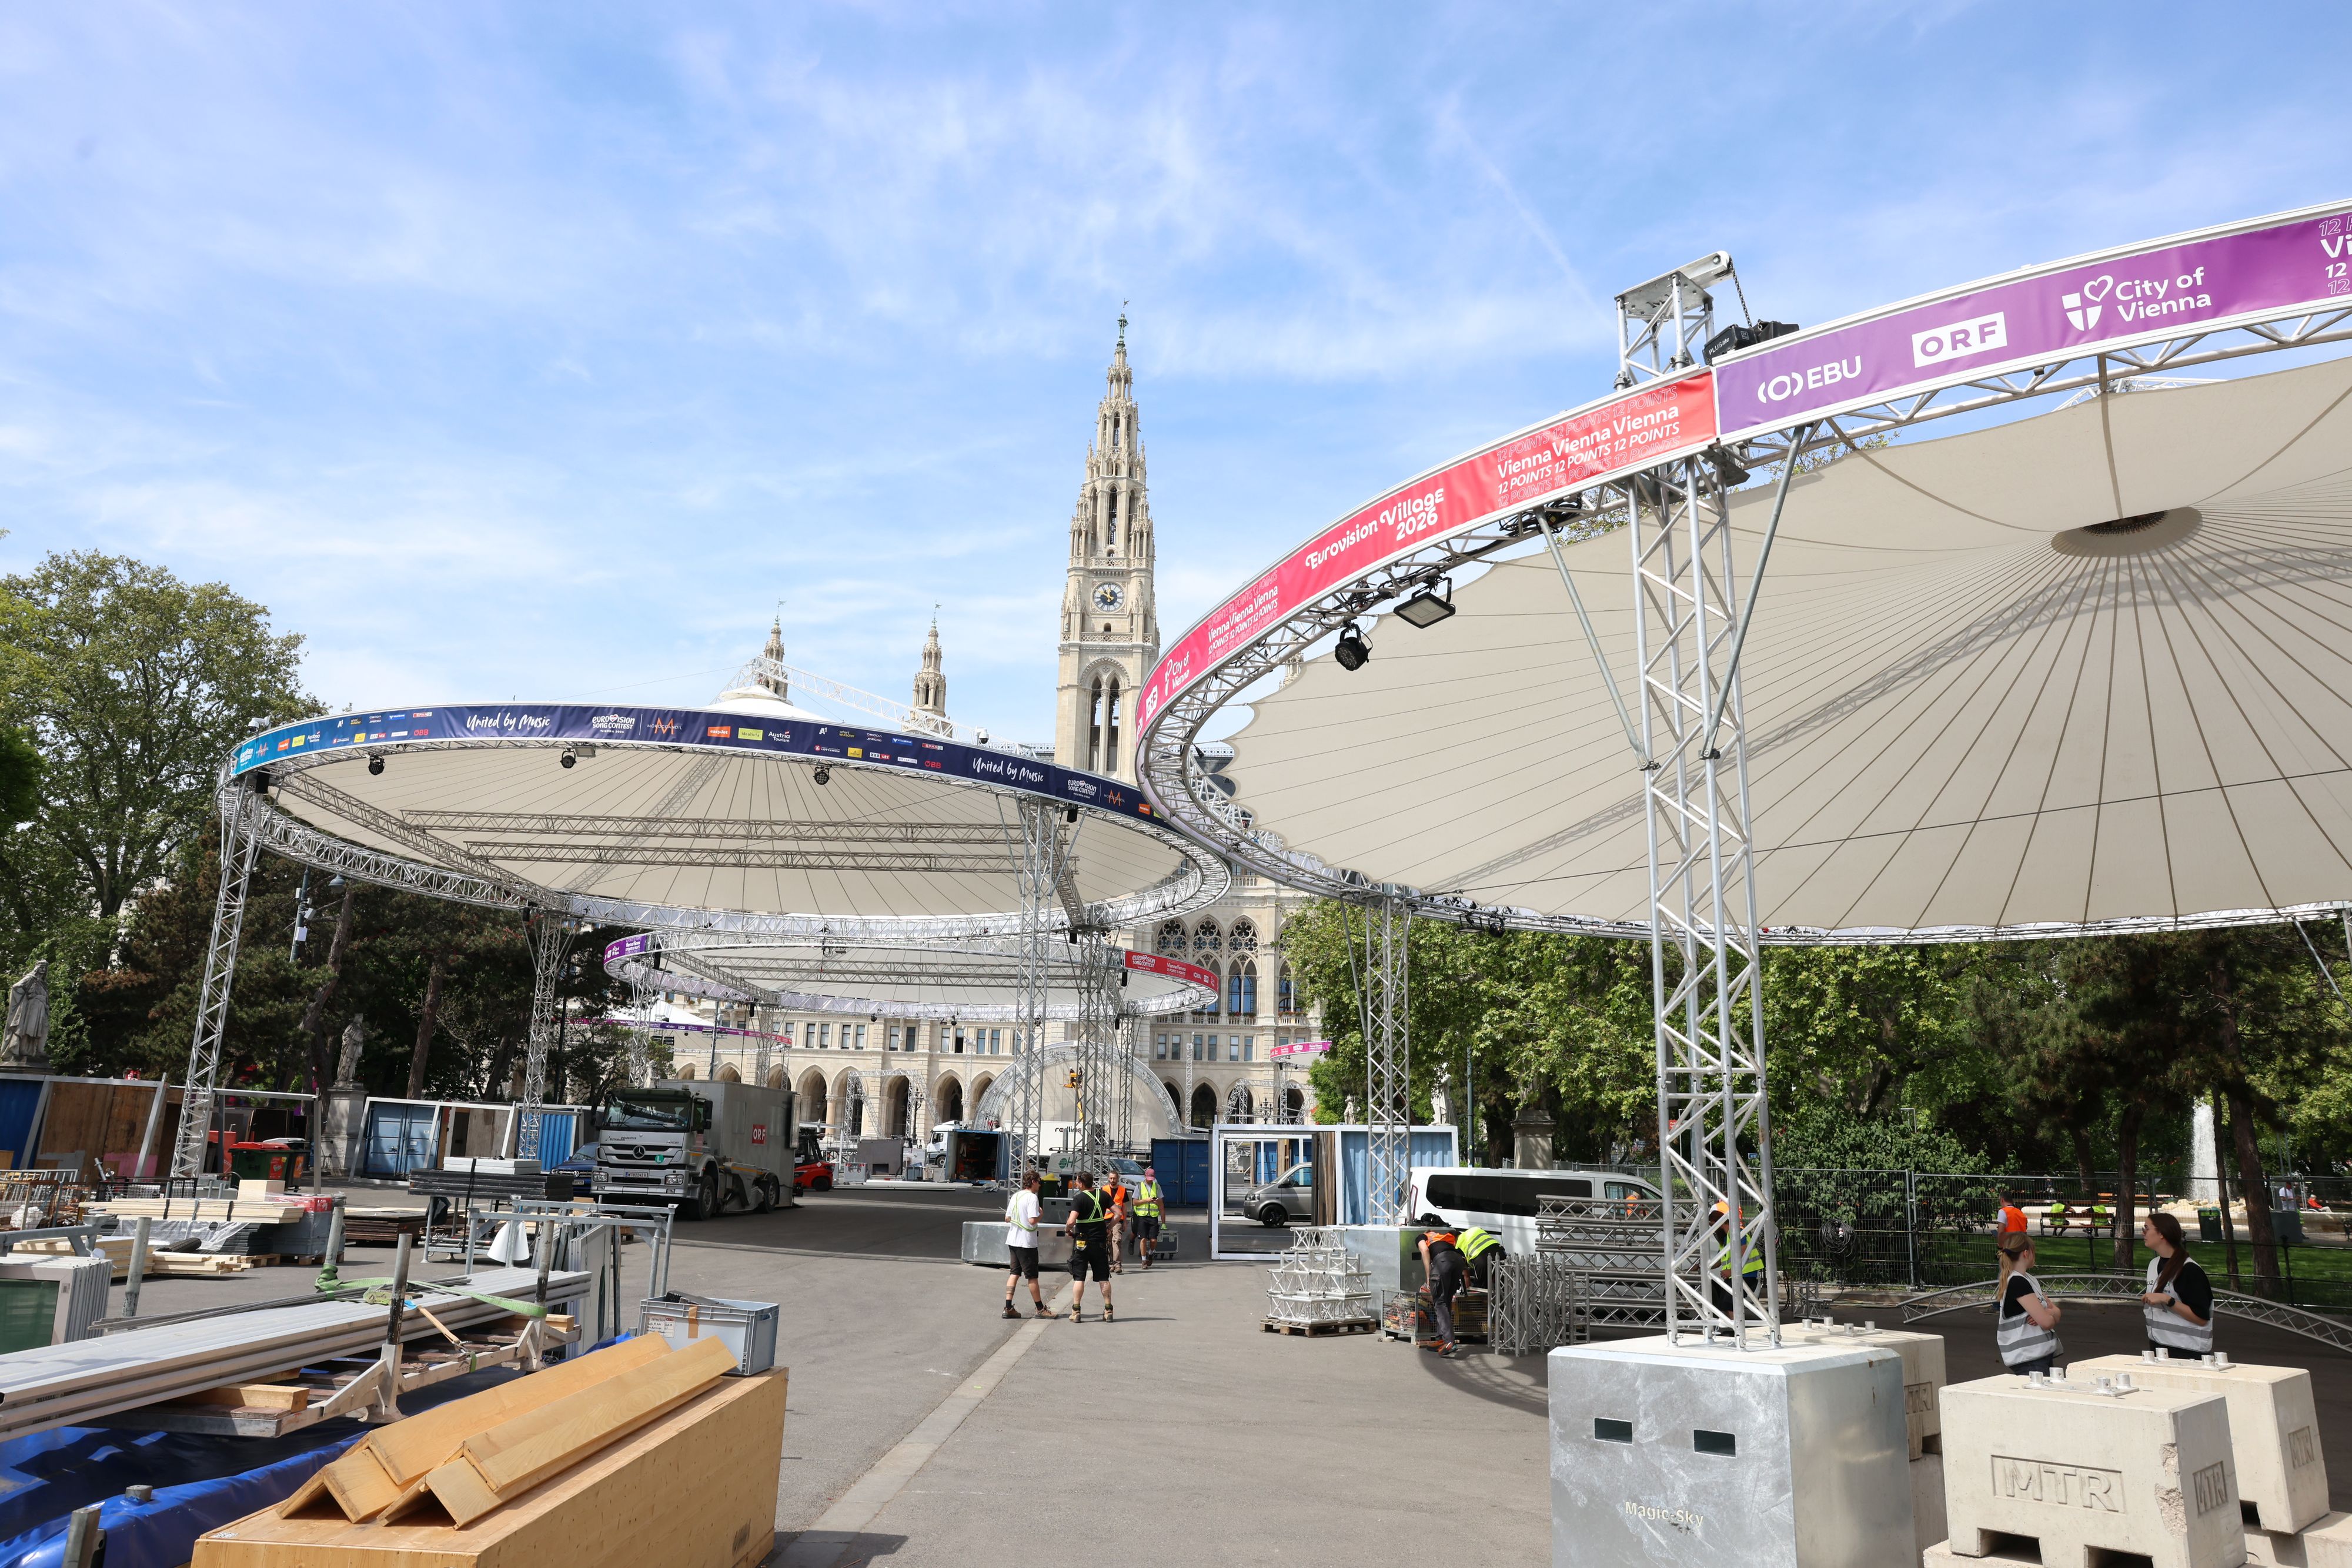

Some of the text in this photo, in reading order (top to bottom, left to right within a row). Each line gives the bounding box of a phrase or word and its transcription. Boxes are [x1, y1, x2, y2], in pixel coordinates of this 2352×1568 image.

[2319, 219, 2341, 236] 12
[2116, 266, 2204, 300] City of
[2325, 262, 2347, 279] 12
[2327, 278, 2350, 295] 12
[2117, 293, 2212, 322] Vienna
[1920, 320, 1998, 357] ORF
[1496, 386, 1678, 462] 12 POINTS 12 POINTS 12 POINTS
[1497, 406, 1679, 479] Vienna Vienna Vienna
[1498, 421, 1680, 495] 12 POINTS 12 POINTS 12 POINTS
[1498, 436, 1681, 508] 12 POINTS 12 POINTS 12 POINTS
[1305, 488, 1444, 570] Eurovision Village
[1396, 506, 1438, 541] 2026
[1208, 586, 1278, 643] Vienna Vienna Vienna
[1212, 633, 1229, 651] POINTS
[1235, 617, 1252, 636] POINTS
[1258, 598, 1278, 617] POINTS
[1172, 651, 1190, 676] City of
[1172, 670, 1190, 690] Vienna
[466, 712, 550, 731] United by Music
[973, 757, 1044, 783] United by Music
[1079, 787, 1095, 796] CONTEST
[753, 1128, 766, 1140] ORF
[2003, 1460, 2119, 1513] MTR
[1625, 1502, 1703, 1527] Magic-Sky
